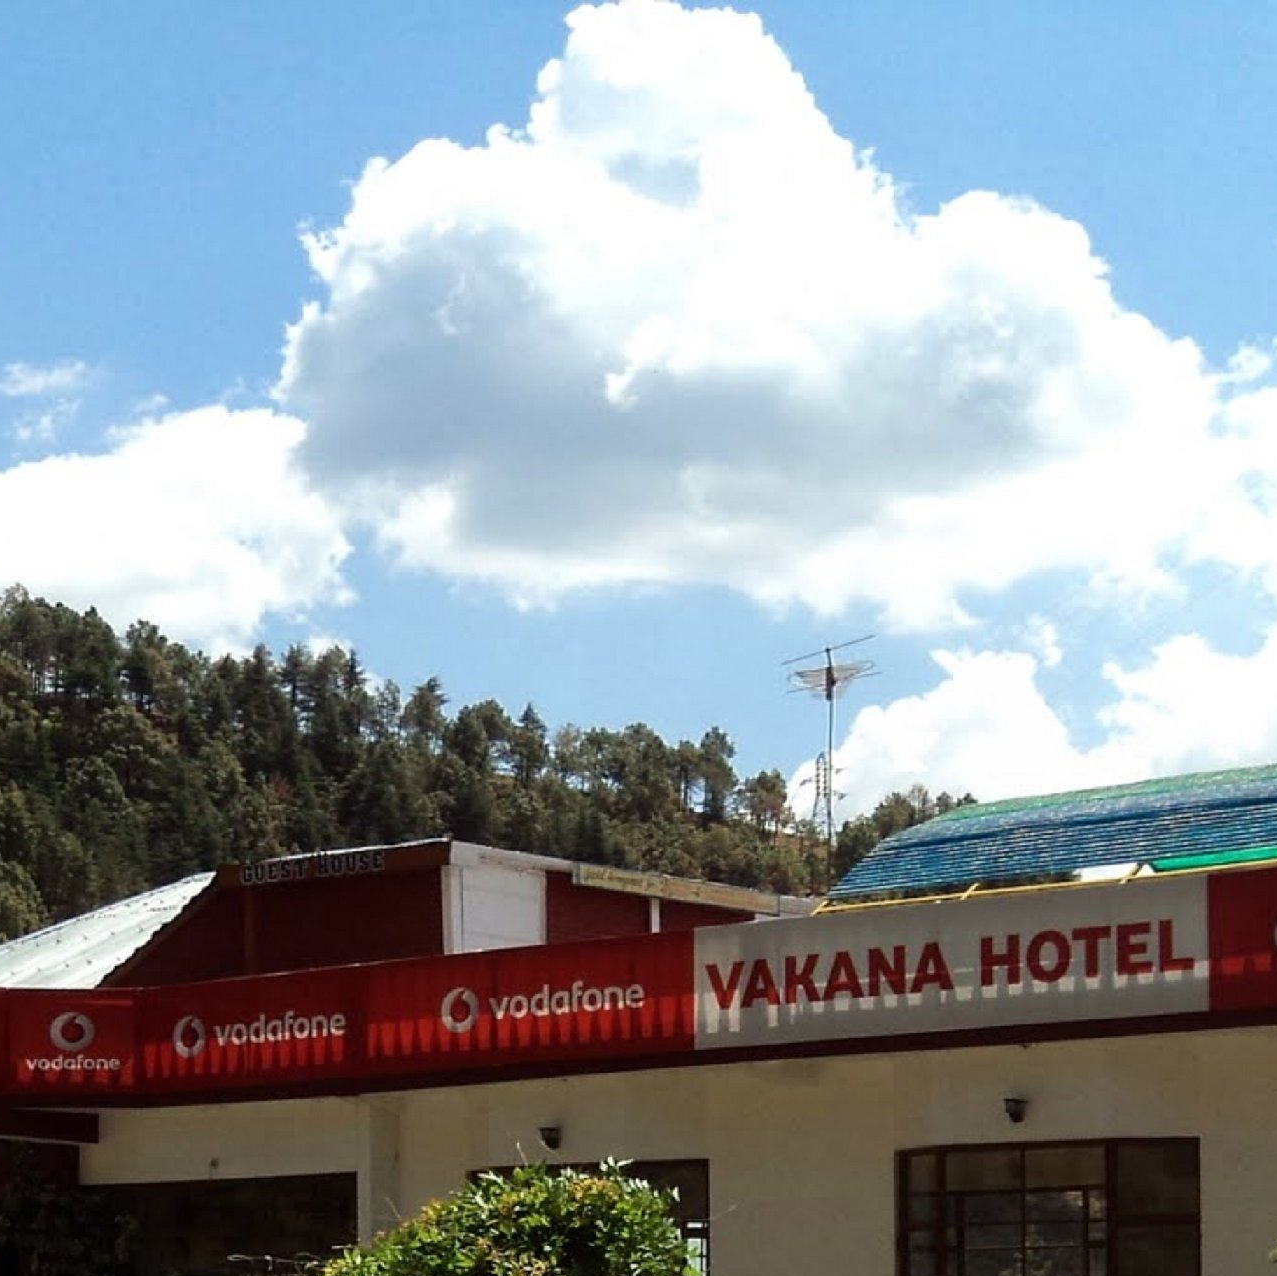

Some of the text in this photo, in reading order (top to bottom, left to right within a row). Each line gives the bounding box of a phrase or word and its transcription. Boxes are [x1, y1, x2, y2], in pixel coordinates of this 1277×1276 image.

[241, 851, 385, 885] GUEST HOUSE
[705, 919, 1194, 1010] VAKANA HOTEL
[487, 981, 646, 1020] vodafone
[213, 1010, 347, 1046] vodafone
[25, 1053, 121, 1072] vodafone
